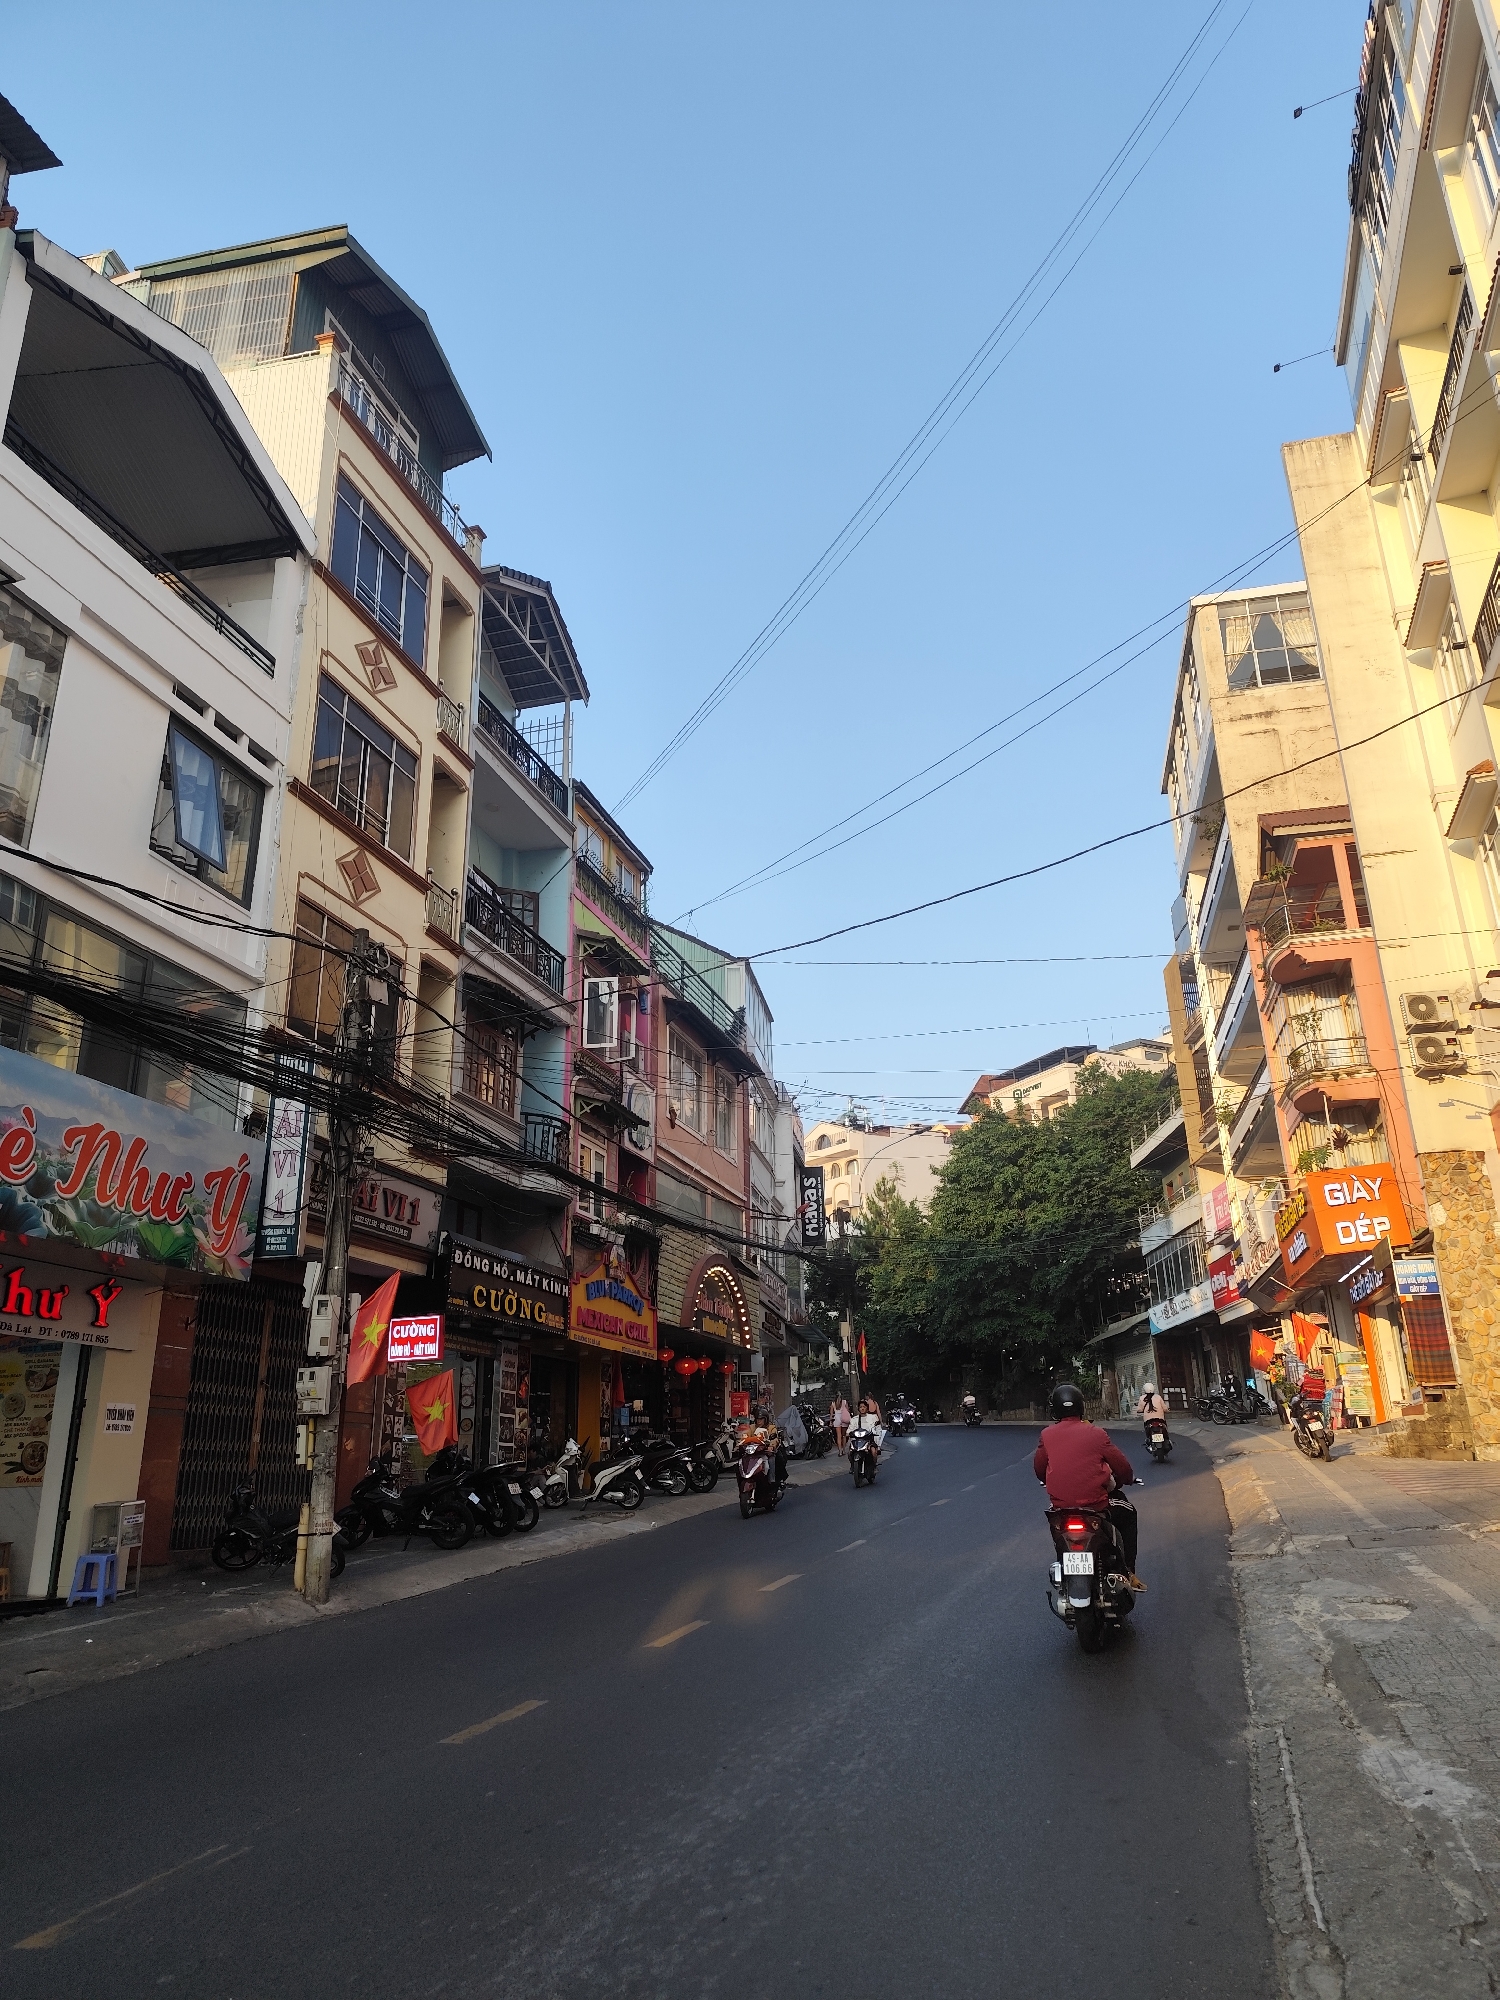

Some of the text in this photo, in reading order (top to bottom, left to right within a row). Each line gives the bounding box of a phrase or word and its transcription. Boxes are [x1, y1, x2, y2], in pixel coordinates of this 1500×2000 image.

[273, 1150, 298, 1178] VI
[55, 1122, 195, 1226] Như
[203, 1153, 252, 1258] Ý
[1324, 1174, 1383, 1207] GIÀY
[1335, 1212, 1391, 1245] DÉP
[454, 1249, 569, 1298] ĐỒNG HỒ MẮT KÍNH
[0, 1264, 124, 1329] hư Ý
[473, 1284, 547, 1324] CƯỜNG
[586, 1279, 645, 1317] BLUE PARROT
[16, 1323, 32, 1335] Lạt
[39, 1326, 53, 1337] ĐT
[61, 1330, 80, 1340] 0789
[81, 1332, 94, 1343] 171
[95, 1334, 109, 1344] 855
[393, 1321, 435, 1339] CƯỜNG
[577, 1305, 624, 1337] MEXICAN
[625, 1321, 650, 1344] GRILL
